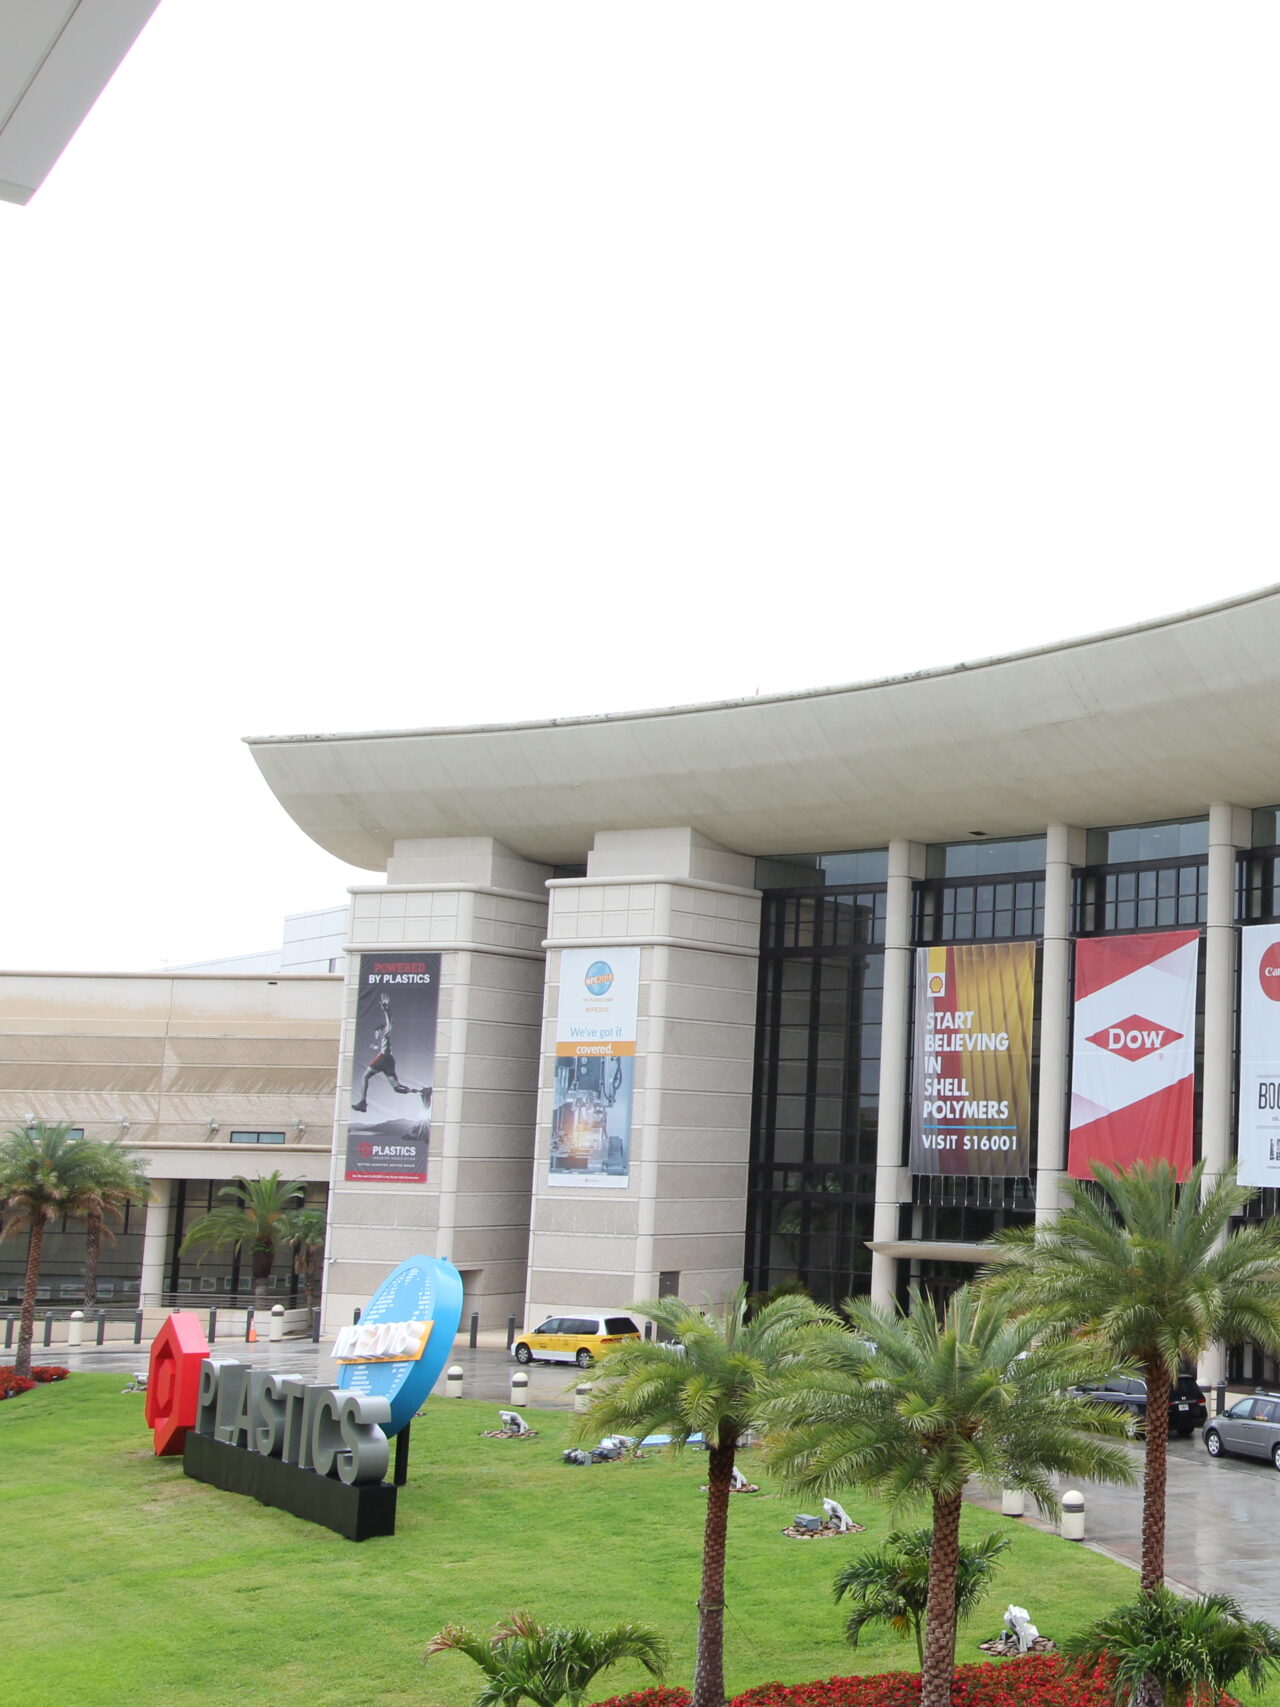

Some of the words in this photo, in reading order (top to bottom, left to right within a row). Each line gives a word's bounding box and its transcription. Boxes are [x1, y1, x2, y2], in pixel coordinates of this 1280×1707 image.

[374, 963, 426, 973] POWERED
[368, 974, 382, 984] BY
[383, 974, 430, 984] PLASTICS
[926, 1011, 974, 1030] START
[570, 1026, 598, 1037] We've
[599, 1028, 614, 1039] got
[615, 1026, 623, 1037] it
[576, 1043, 614, 1054] covered.
[924, 1032, 1009, 1052] BELIEVING
[924, 1056, 942, 1074] IN
[924, 1078, 969, 1097] SHELL
[922, 1100, 1009, 1120] POLYMERS
[373, 1145, 416, 1156] PLASTICS
[921, 1134, 958, 1150] VISIT
[963, 1135, 1017, 1151] S16001
[195, 1358, 392, 1486] PLASTICS
